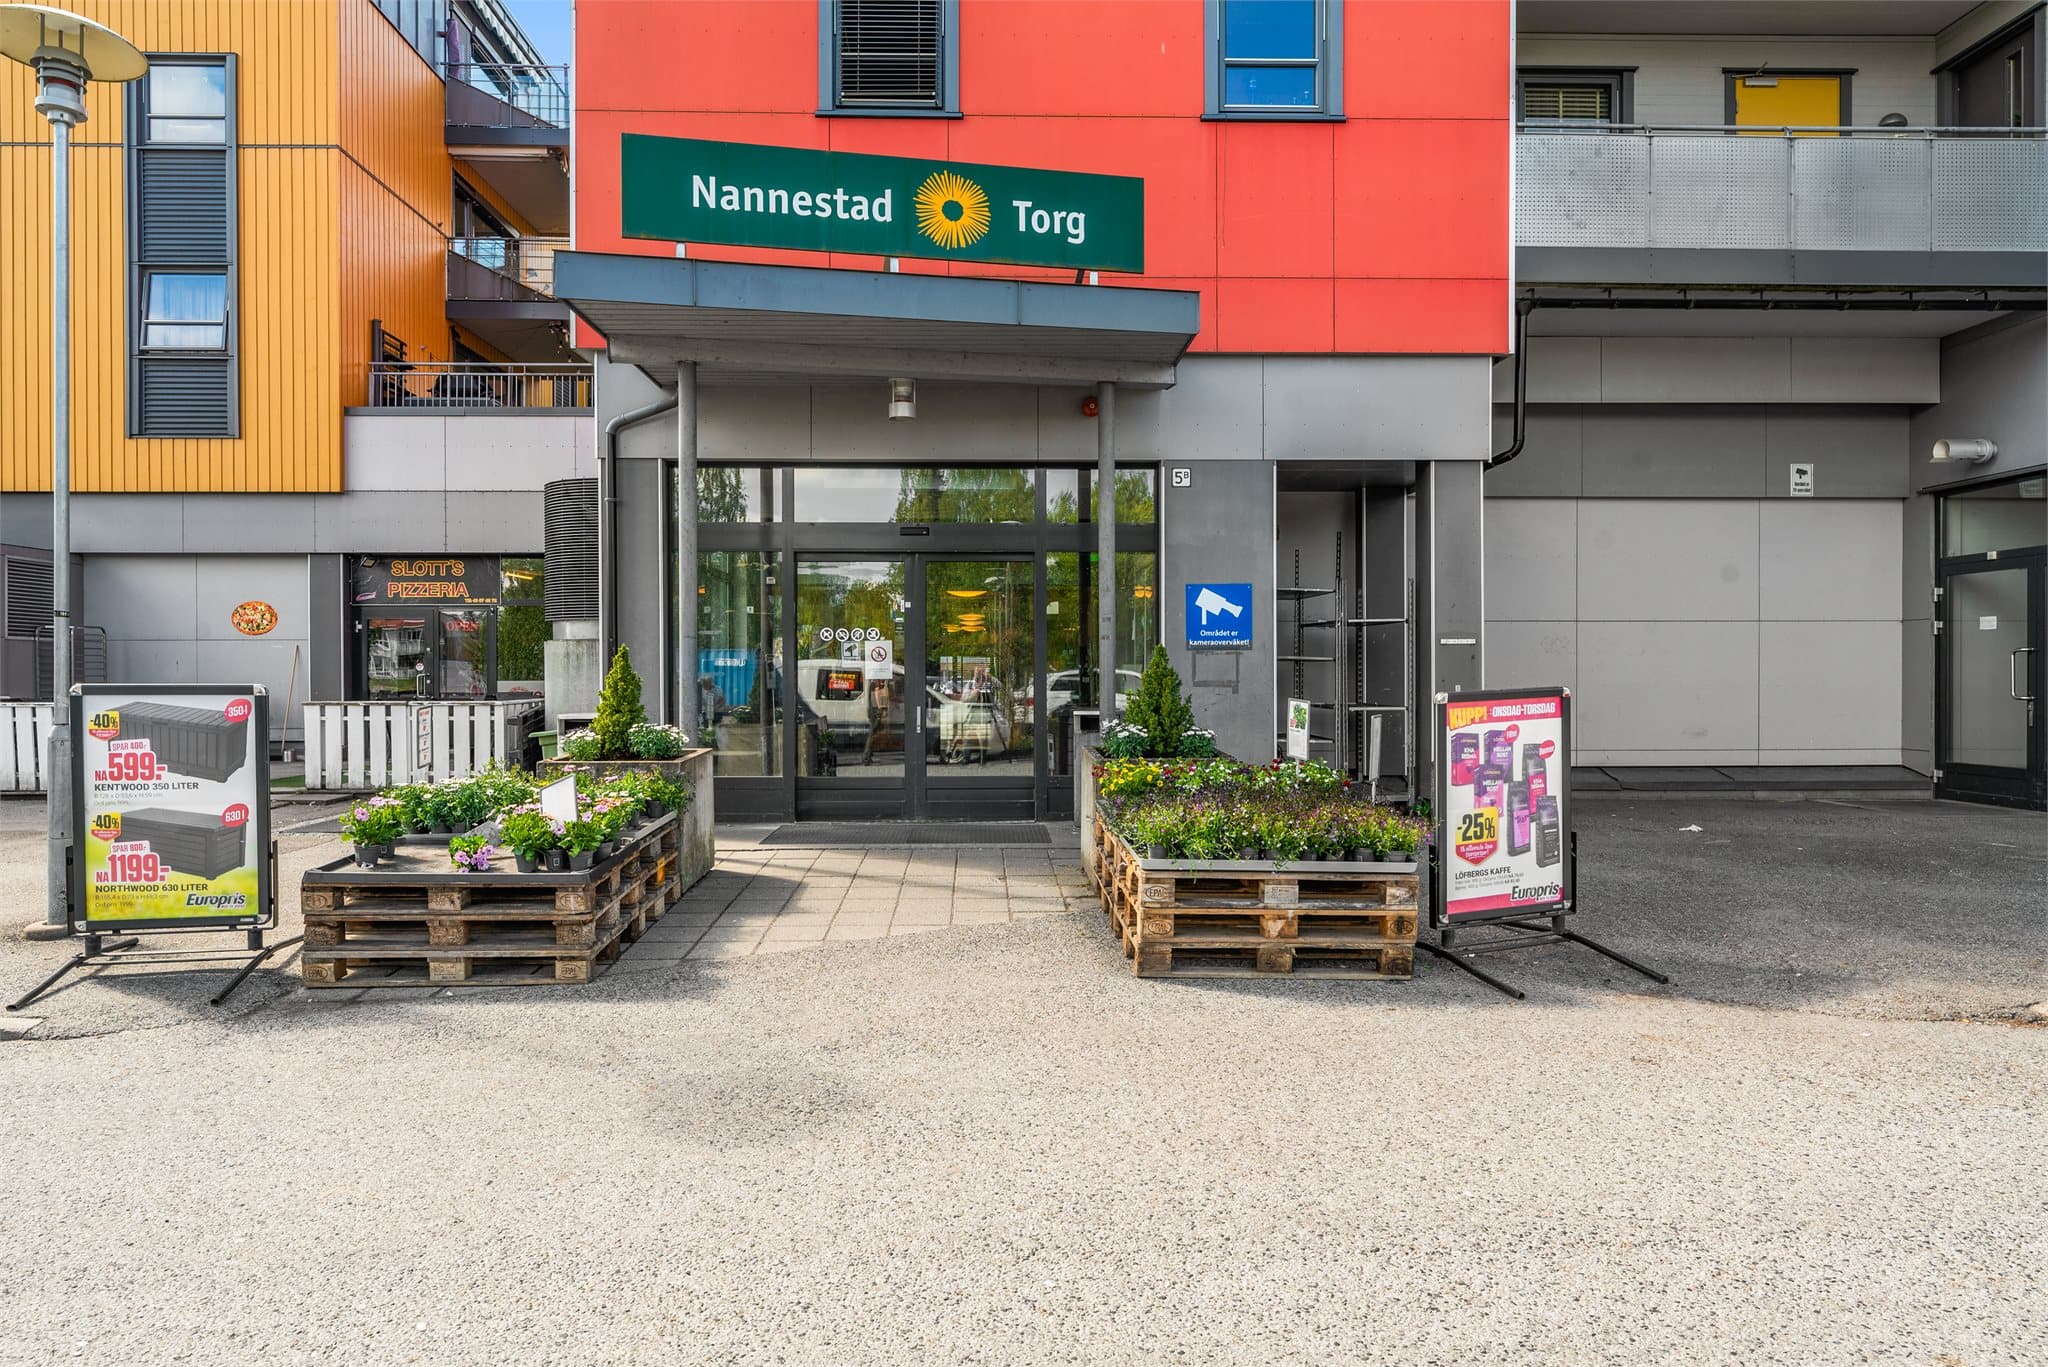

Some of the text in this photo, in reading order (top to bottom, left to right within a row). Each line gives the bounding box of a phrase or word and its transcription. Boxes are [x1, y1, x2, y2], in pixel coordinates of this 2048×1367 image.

[692, 174, 1086, 245] Nannestad Torg
[388, 582, 469, 598] PIZZERIA
[445, 620, 479, 632] OPEN
[90, 714, 118, 728] -40%
[1449, 706, 1487, 730] KUPP!
[112, 743, 129, 751] SPAR
[94, 782, 200, 791] KENTWOOD 350 LITER
[92, 815, 119, 829] -40%
[225, 813, 240, 822] 630
[1457, 813, 1495, 841] -25%
[1490, 866, 1511, 876] KAFFE
[95, 884, 159, 893] NORTHWOOD
[181, 883, 208, 891] LITER
[1511, 882, 1560, 901] Europris
[186, 892, 246, 908] Europris
